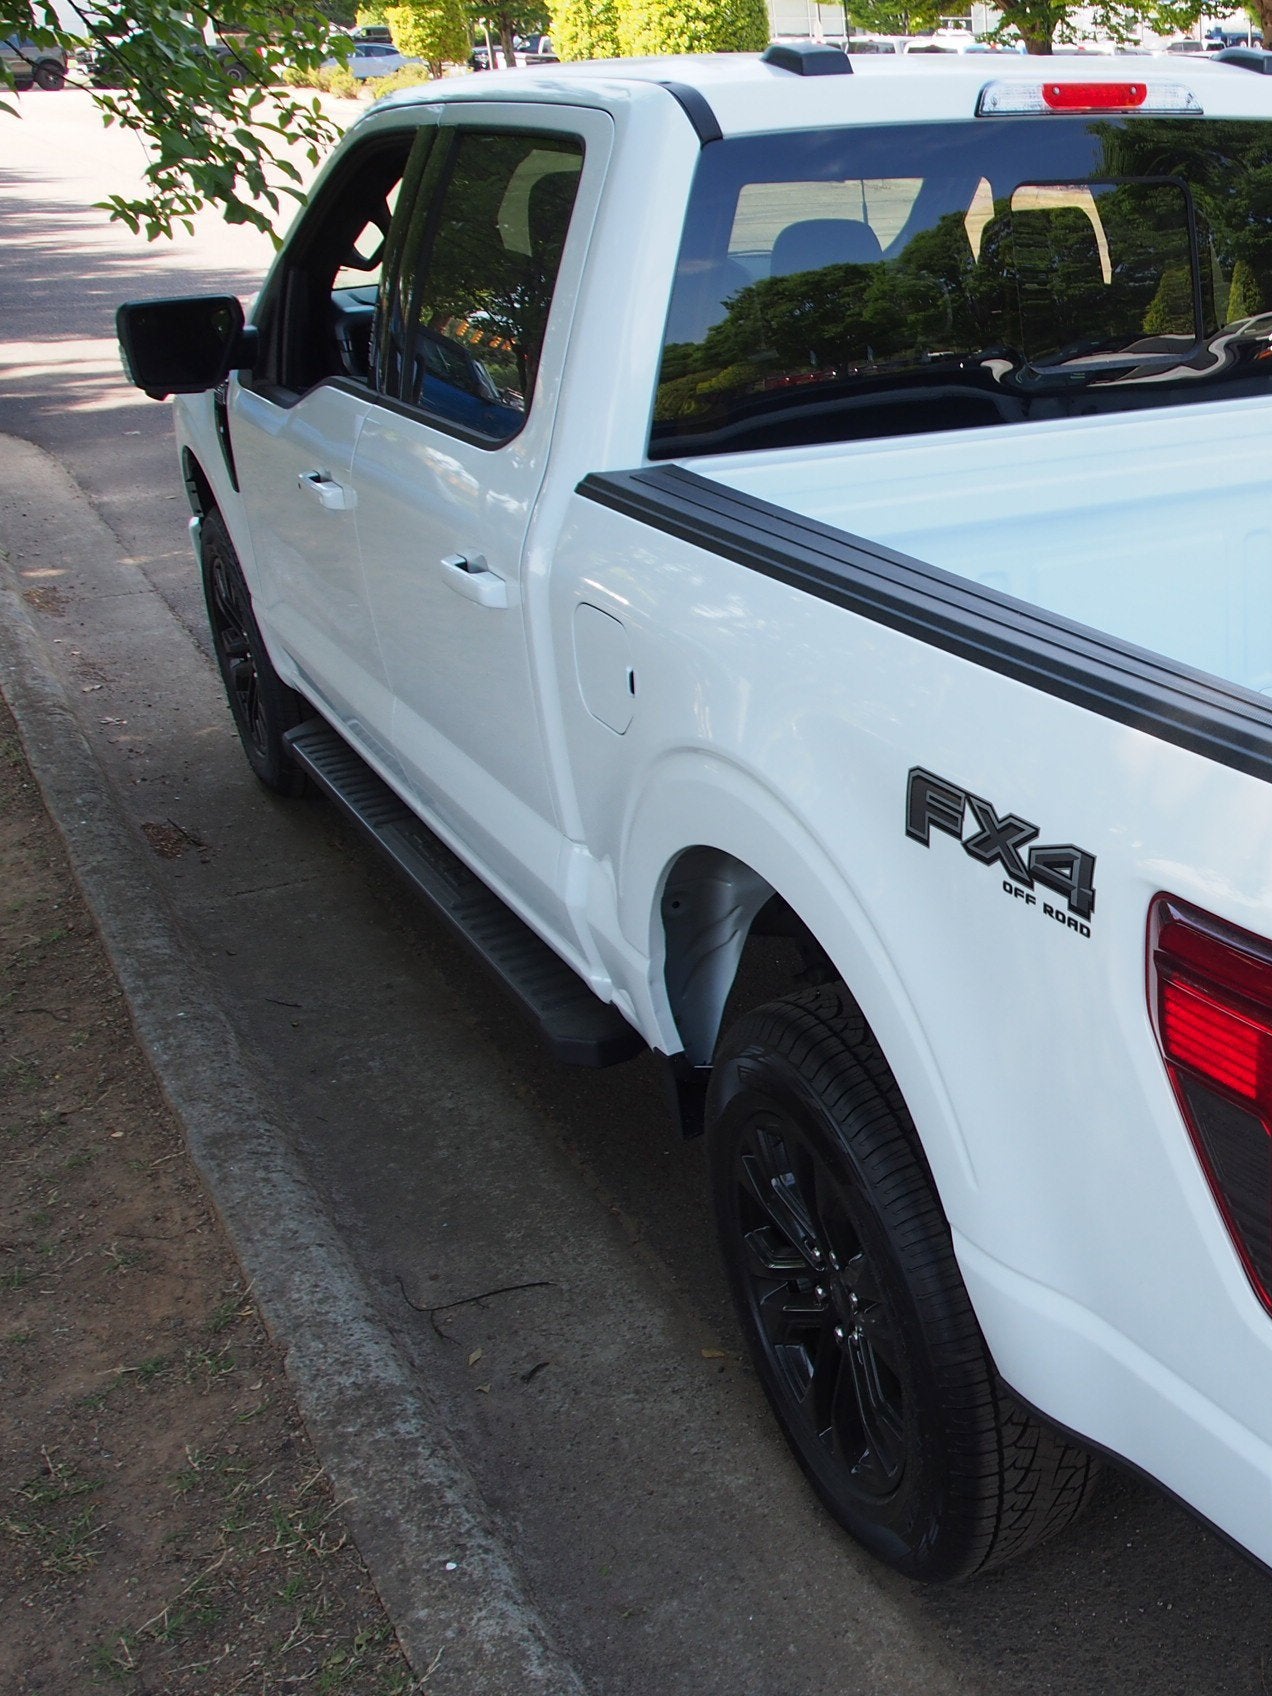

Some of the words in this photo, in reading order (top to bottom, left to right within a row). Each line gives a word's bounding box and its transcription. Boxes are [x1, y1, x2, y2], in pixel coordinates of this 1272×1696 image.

[905, 765, 1097, 923] FX4
[1002, 880, 1037, 906] OFF
[1043, 901, 1092, 939] ROAD
